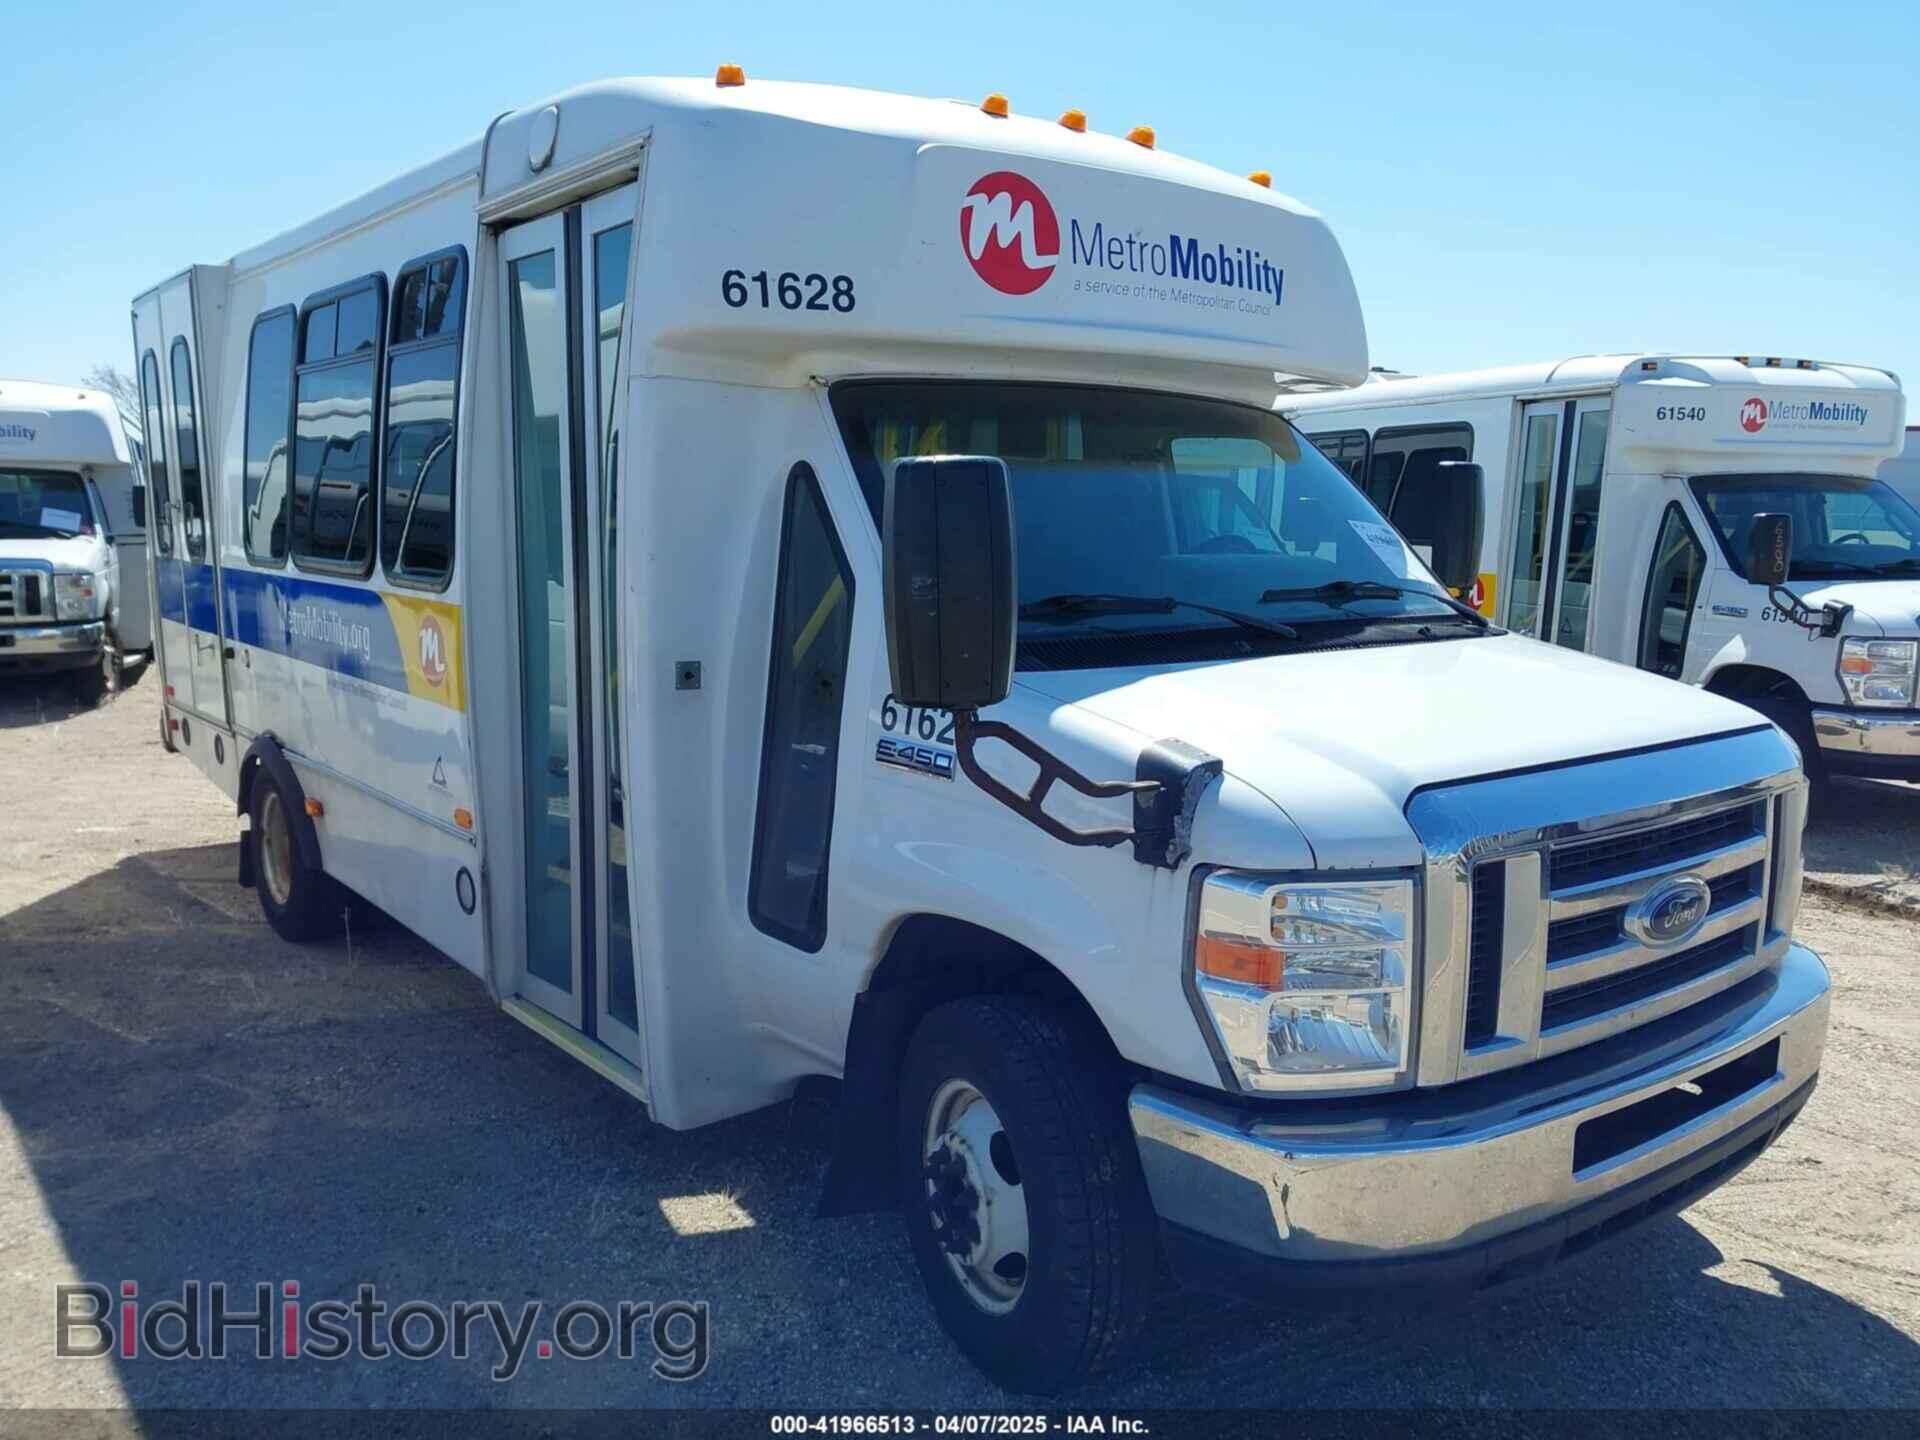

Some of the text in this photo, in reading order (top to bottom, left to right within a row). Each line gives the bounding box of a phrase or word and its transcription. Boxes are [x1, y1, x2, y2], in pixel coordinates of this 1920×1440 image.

[1071, 218, 1284, 306] MetroMobility
[721, 269, 857, 313] 61628
[1085, 280, 1129, 297] service
[1149, 286, 1168, 301] the
[1656, 406, 1706, 422] 61540
[1768, 400, 1869, 426] MetroMobility
[1761, 606, 1808, 623] 6150
[881, 693, 979, 746] 6162
[876, 739, 953, 772] E-450
[1665, 896, 1699, 928] Ford
